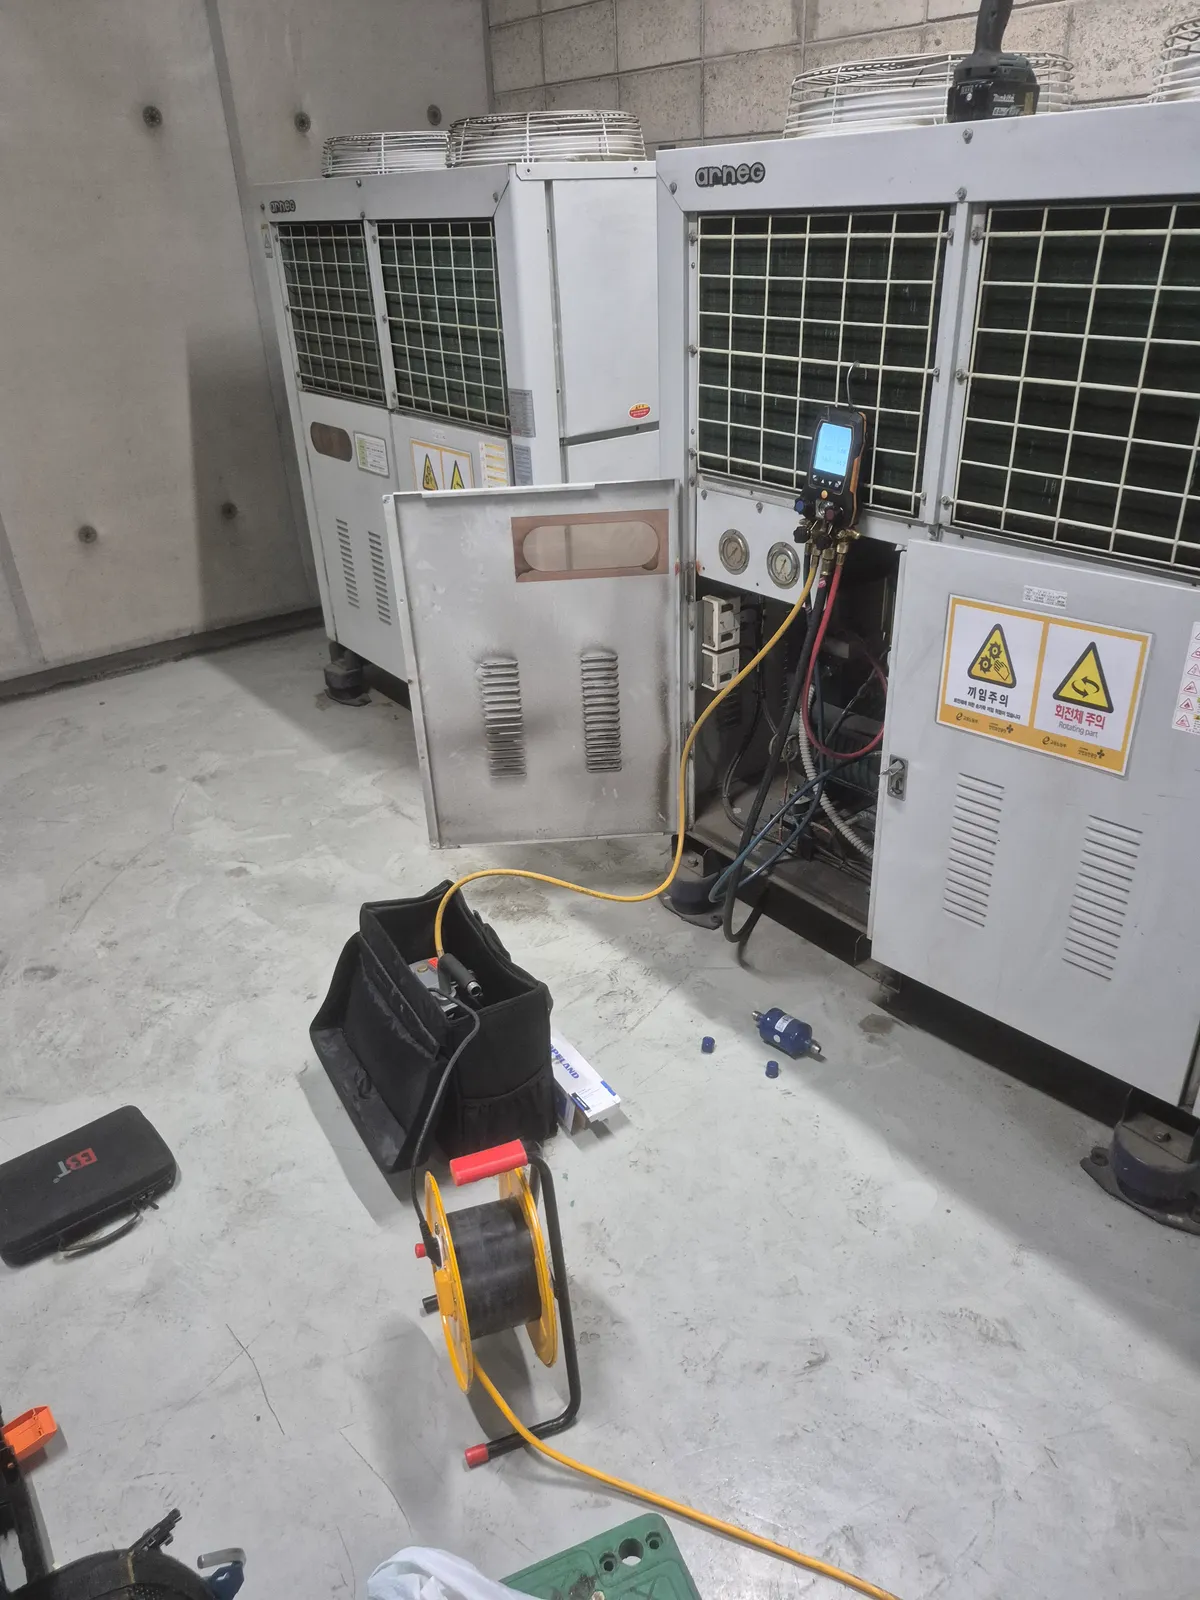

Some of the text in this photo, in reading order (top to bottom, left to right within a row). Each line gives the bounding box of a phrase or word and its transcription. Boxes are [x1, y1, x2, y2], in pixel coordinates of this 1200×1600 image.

[1055, 704, 1106, 730] 회전체 주의
[1058, 721, 1098, 738] Rotating part
